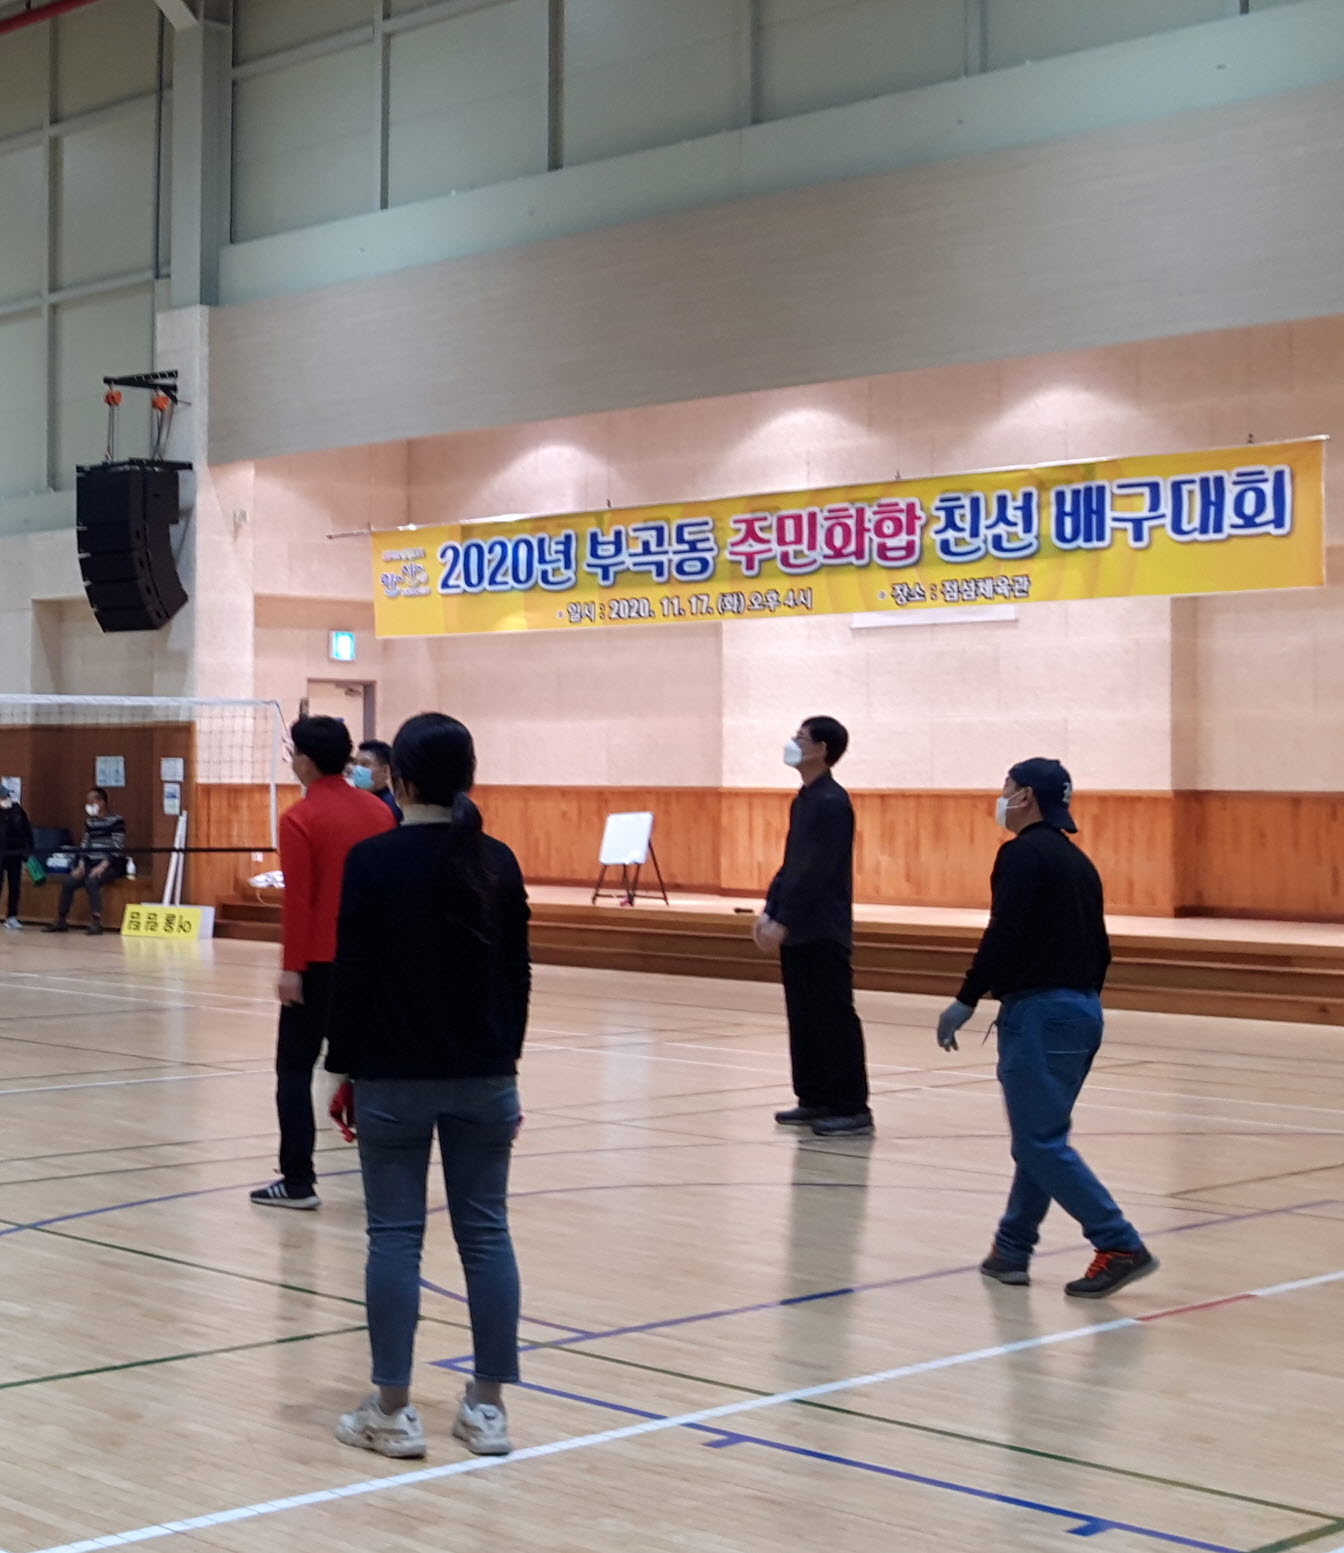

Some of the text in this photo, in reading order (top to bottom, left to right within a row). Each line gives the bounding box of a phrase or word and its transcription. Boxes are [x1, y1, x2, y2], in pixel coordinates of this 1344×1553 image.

[438, 464, 1294, 594] 2020년 부곡동 주민화합 친선 배구대회
[892, 582, 926, 606] 장소
[567, 602, 595, 624] 일시
[608, 598, 655, 620] 2020.
